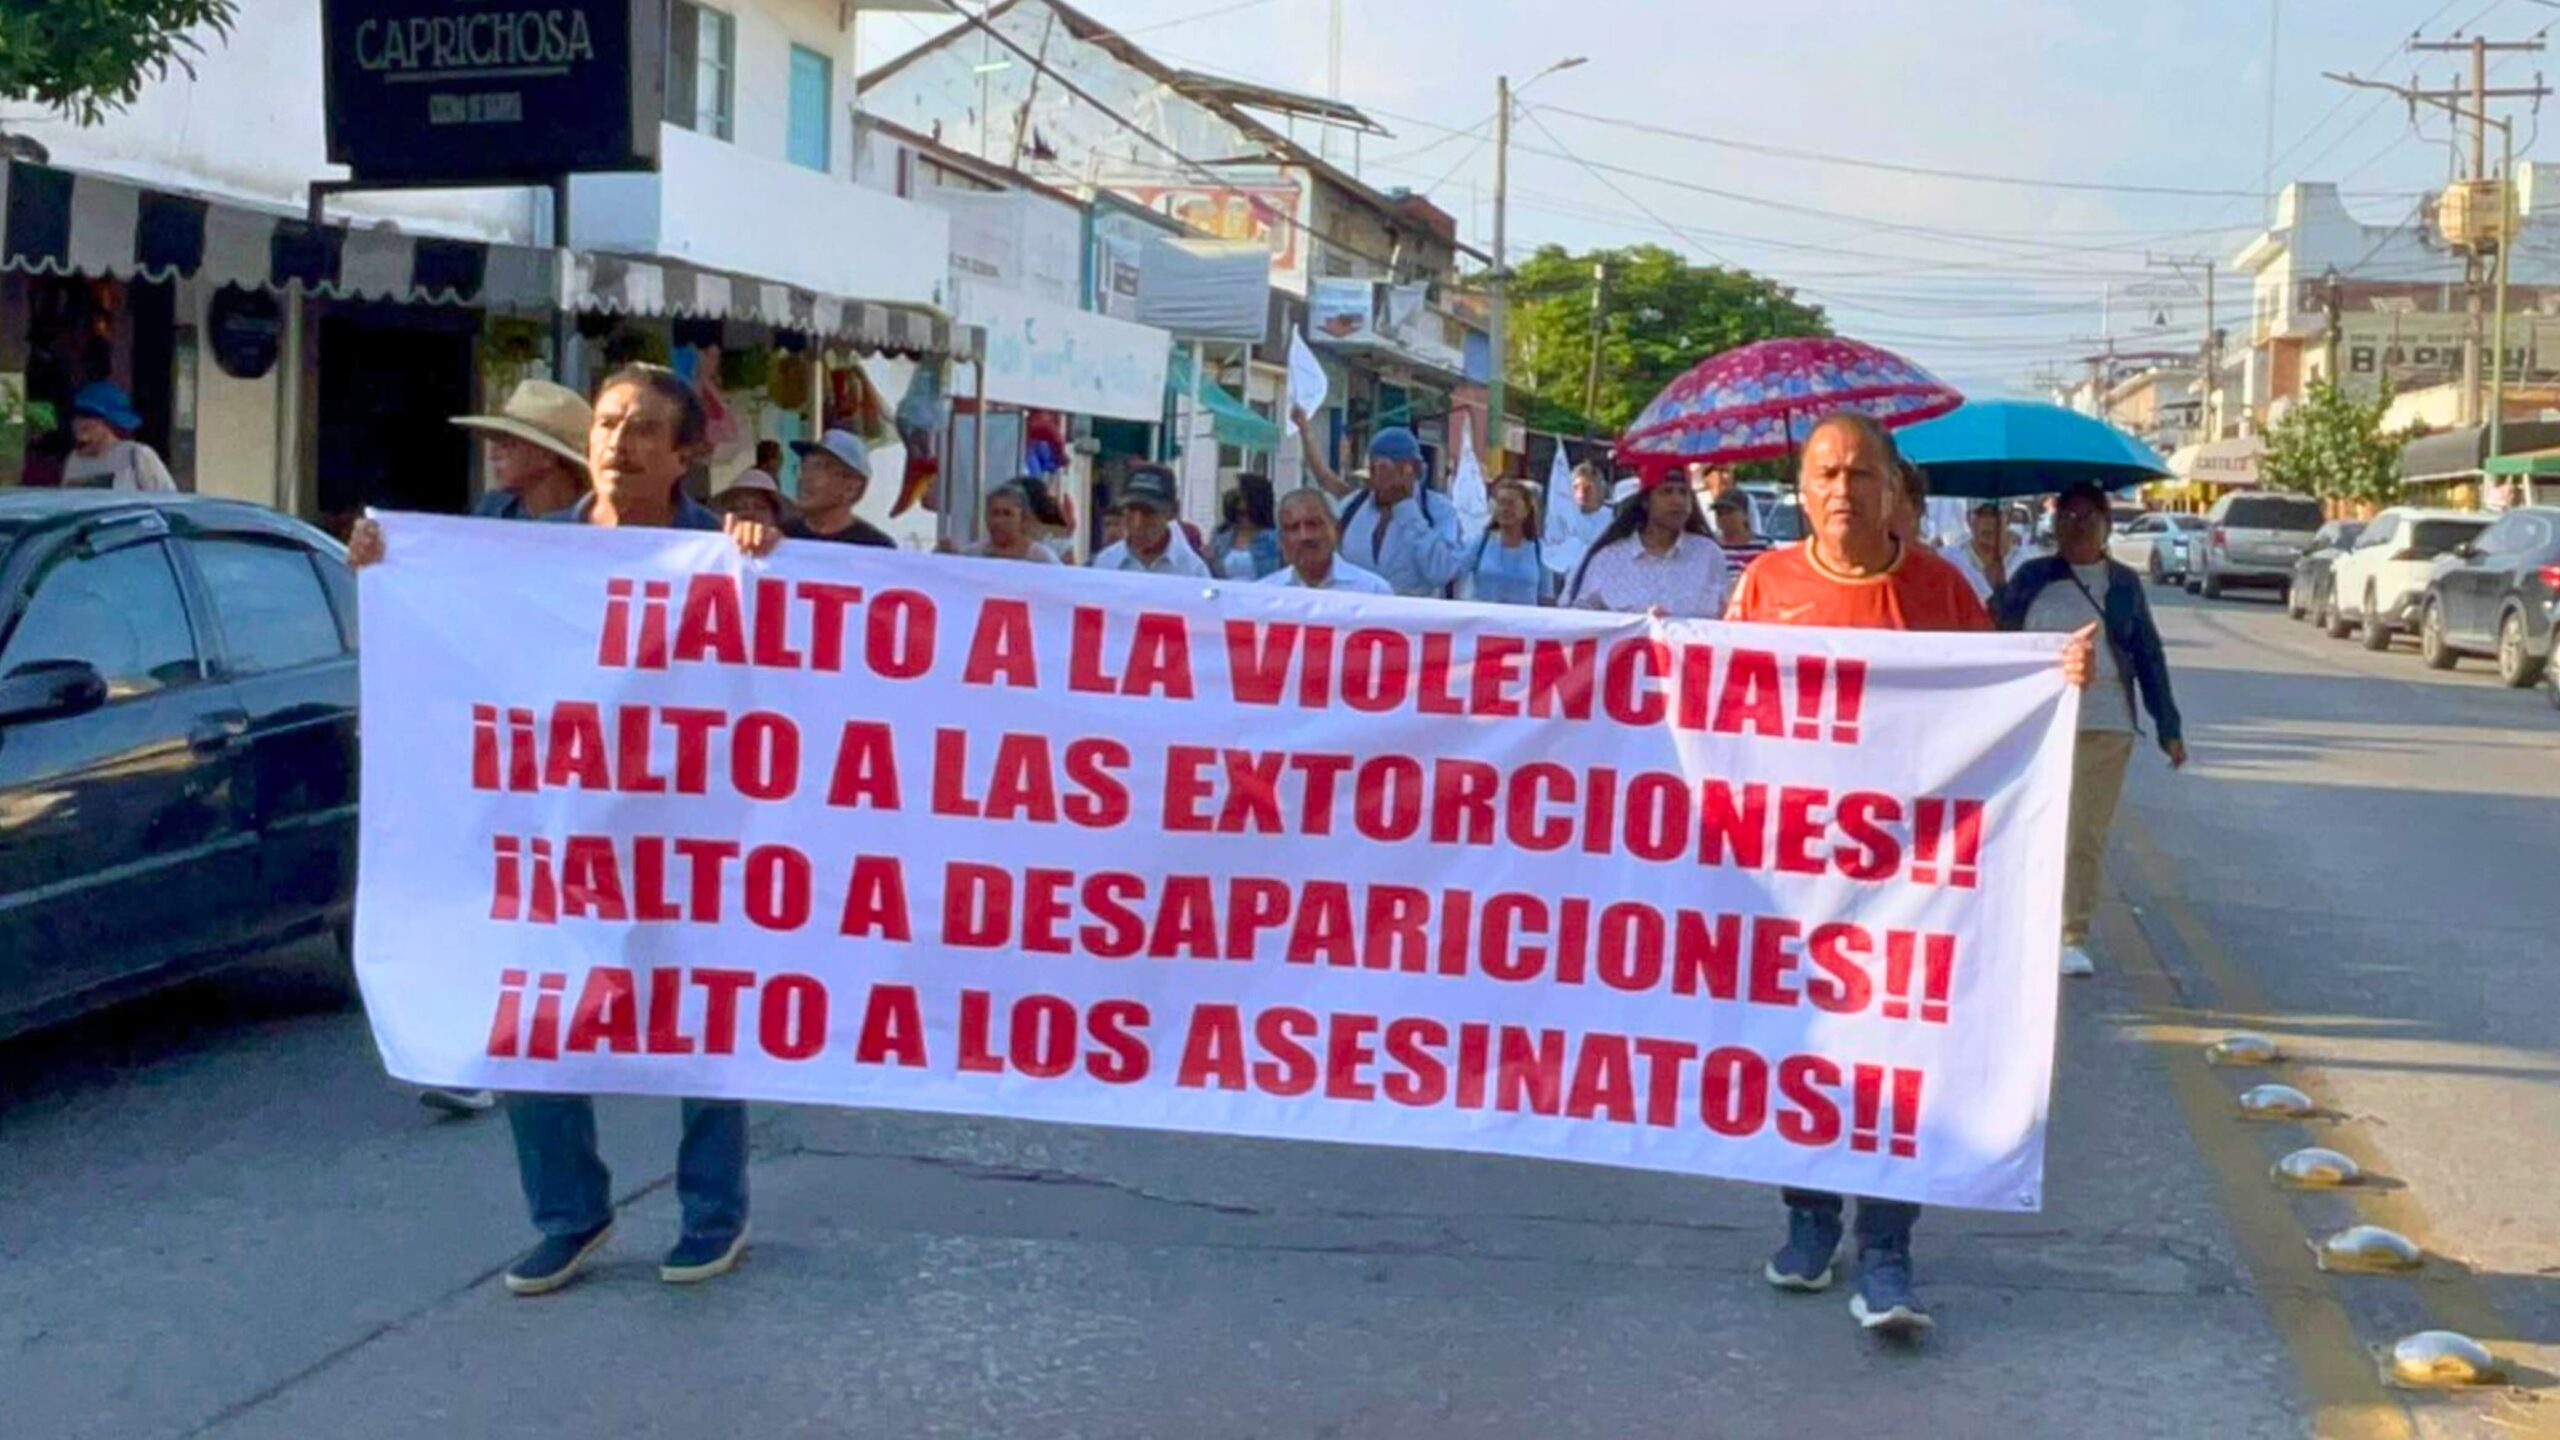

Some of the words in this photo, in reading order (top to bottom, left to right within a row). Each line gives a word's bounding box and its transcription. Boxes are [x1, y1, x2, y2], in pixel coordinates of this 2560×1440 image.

[356, 9, 594, 70] CAPRICHOSA
[601, 574, 936, 678] ¡¡ALTO
[966, 599, 1036, 686] A
[1071, 606, 1193, 698] LA
[1225, 620, 1864, 744] VIOLENCIA!!
[473, 703, 800, 800] ¡¡ALTO
[830, 721, 900, 809] A
[933, 730, 1130, 827] LAS
[1164, 746, 1983, 889] EXTORCIONES!!
[492, 836, 811, 931] ¡¡ALTO
[842, 856, 910, 940] A
[944, 863, 1955, 1024] DESAPARICIONES!!
[490, 968, 828, 1059] ¡¡ALTO
[858, 985, 925, 1066] A
[960, 991, 1149, 1083] LOS
[1180, 1005, 1922, 1156] ASESINATOS!!
